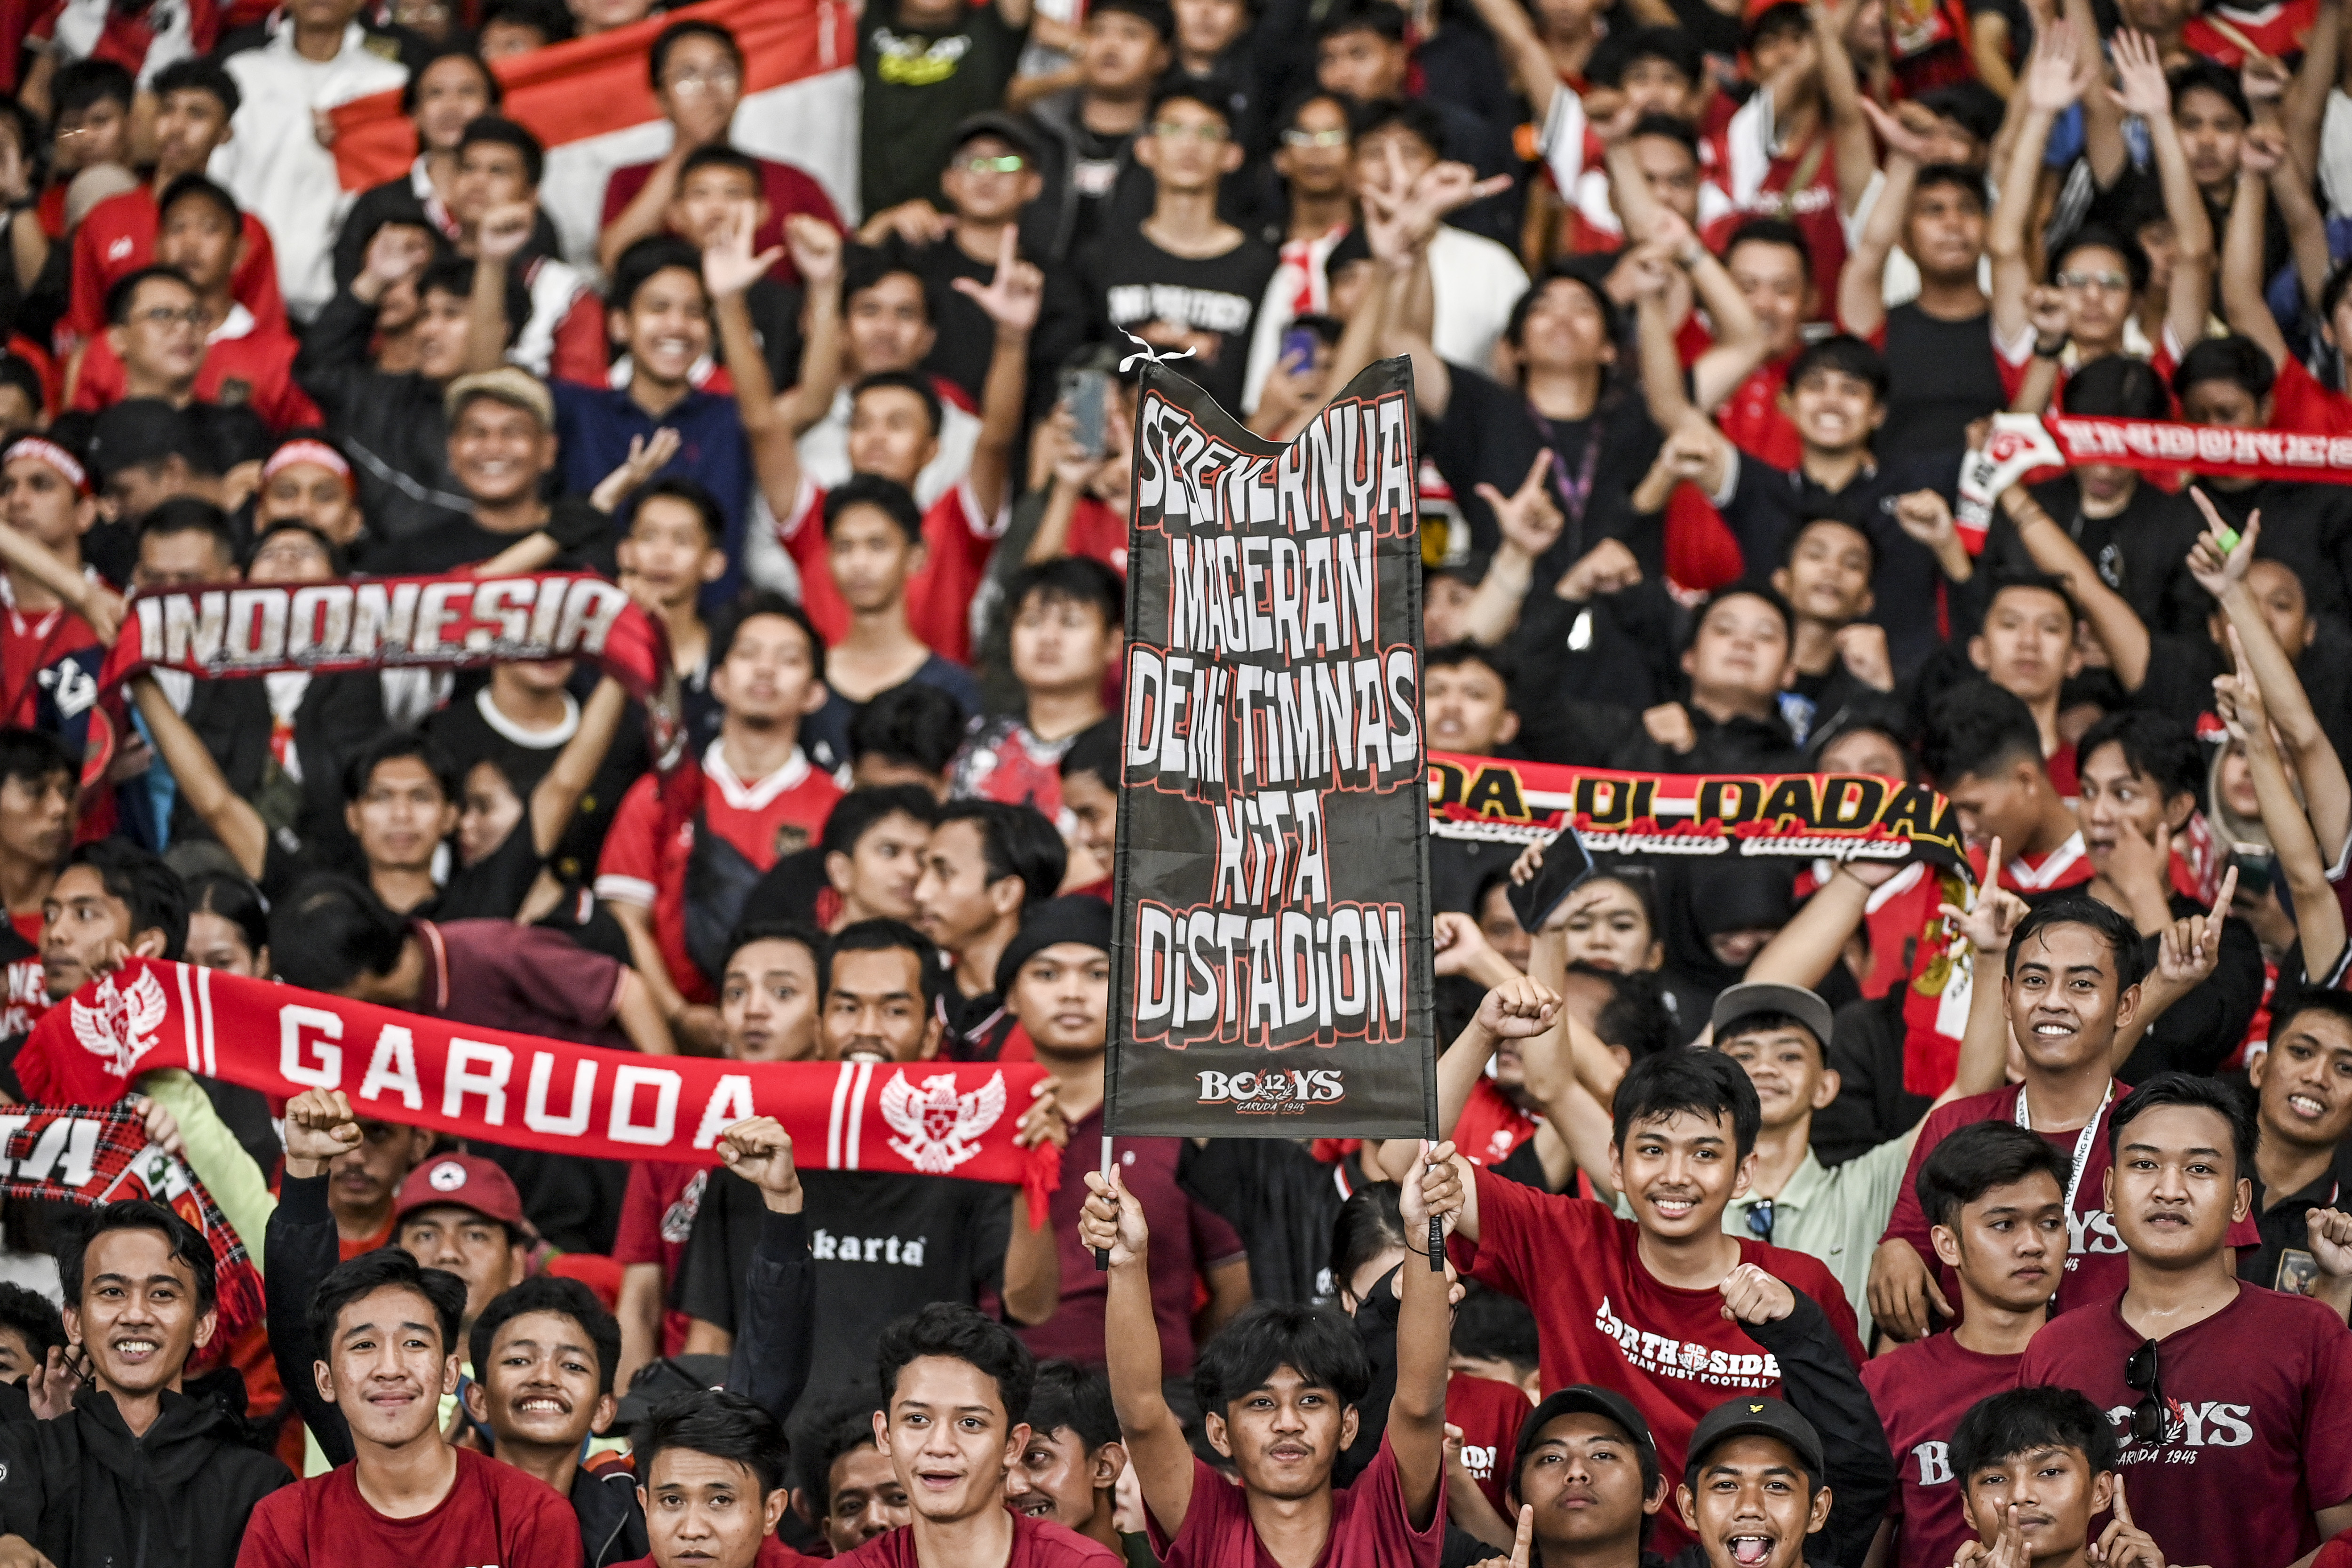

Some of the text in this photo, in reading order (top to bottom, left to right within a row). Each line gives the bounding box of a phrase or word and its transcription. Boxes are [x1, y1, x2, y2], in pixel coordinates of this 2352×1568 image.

[138, 577, 628, 666] INDONESIA
[1173, 530, 1371, 658] MAGERAN
[1694, 773, 1966, 847] DADA
[279, 1004, 754, 1150] GARUDA
[1237, 1102, 1305, 1111] GARUDA 1945
[1660, 1365, 1695, 1381] JUST
[2165, 1449, 2198, 1465] 1945
